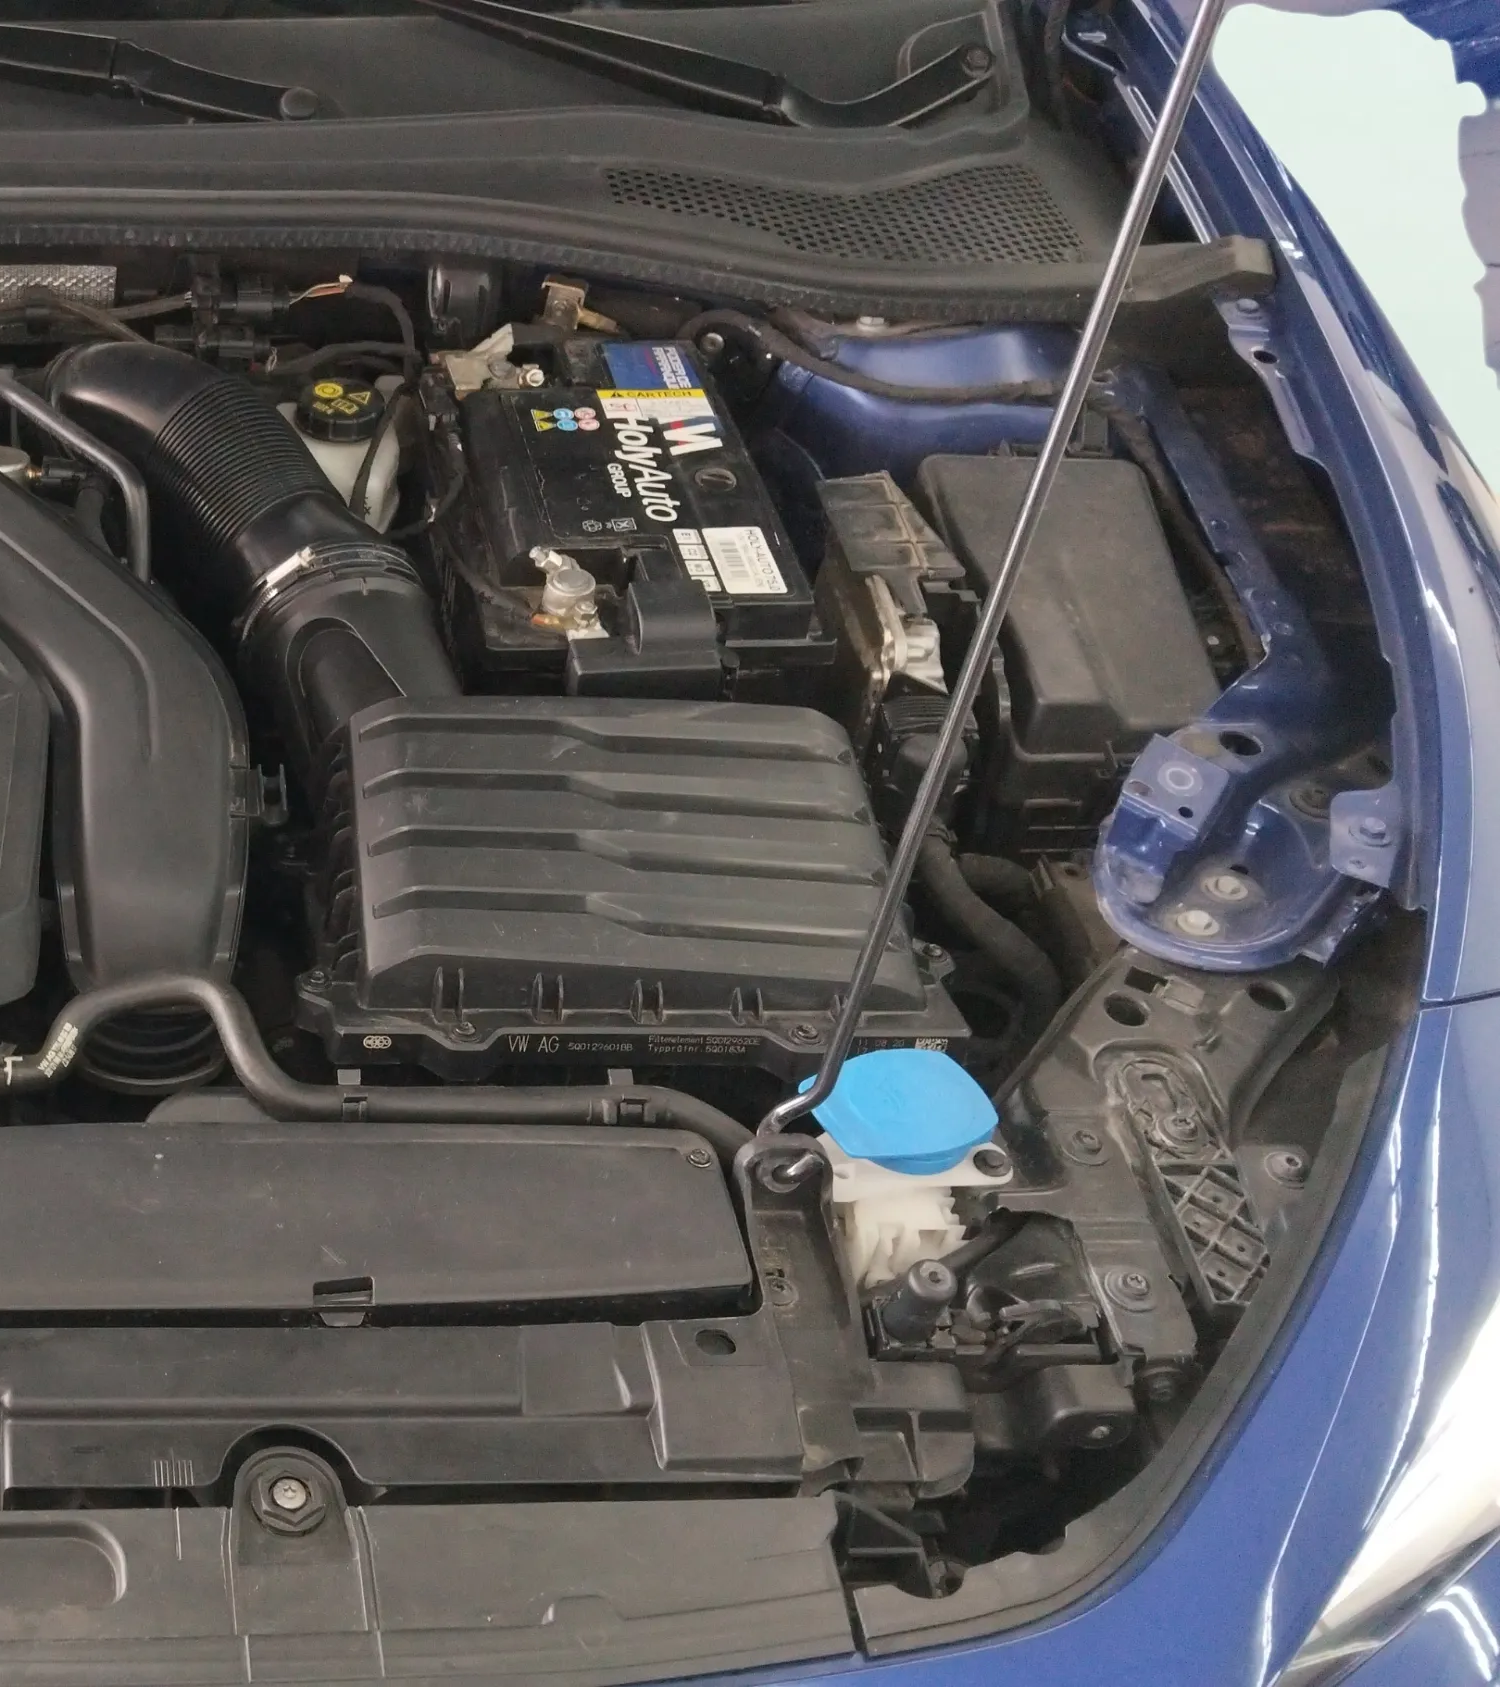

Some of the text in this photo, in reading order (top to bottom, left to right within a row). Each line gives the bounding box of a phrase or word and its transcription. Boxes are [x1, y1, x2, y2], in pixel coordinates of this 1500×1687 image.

[652, 346, 682, 389] ARRANQU
[607, 462, 633, 498] GROUP
[611, 414, 682, 522] HolyAuto
[508, 1034, 530, 1053] VW
[537, 1035, 560, 1053] AG
